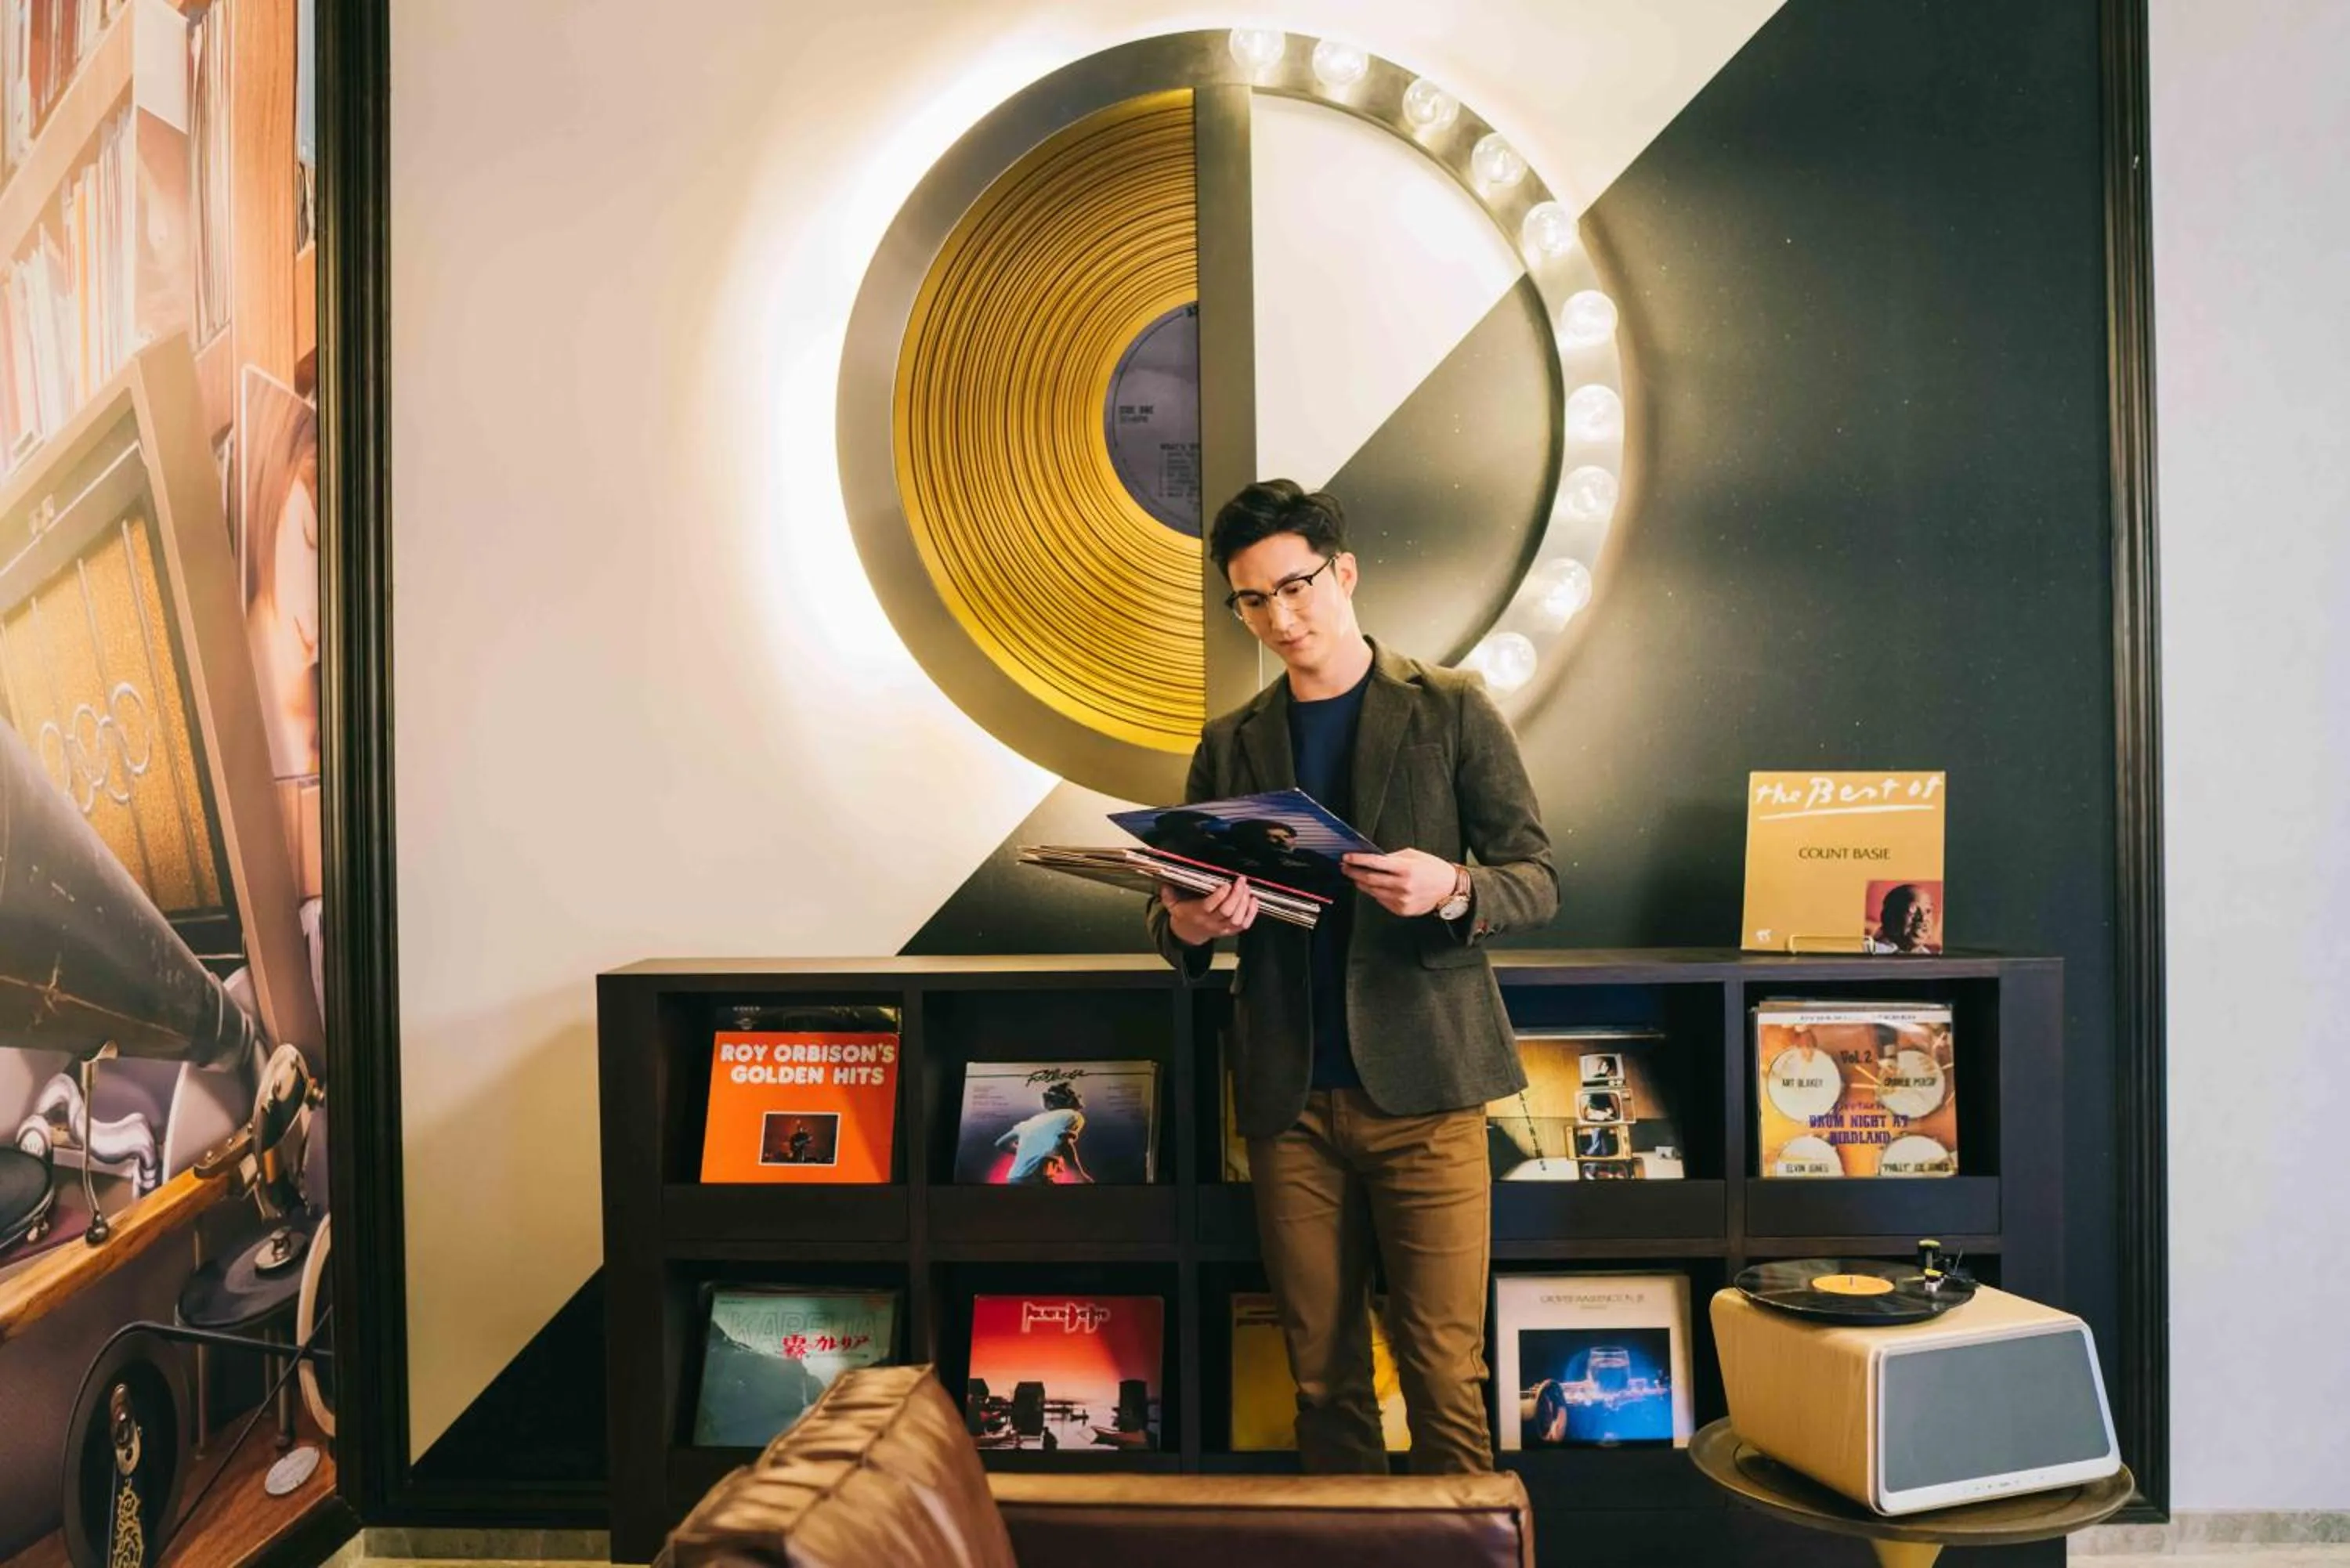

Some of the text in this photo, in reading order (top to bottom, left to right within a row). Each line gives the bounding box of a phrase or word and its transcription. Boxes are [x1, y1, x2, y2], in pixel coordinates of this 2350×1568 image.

[1805, 776, 1899, 809] Best
[1799, 847, 1891, 860] COUNT BASIE
[720, 1042, 895, 1064] ROY ORBISON'S
[1864, 1050, 1873, 1064] 2
[730, 1065, 885, 1086] GOLDEN HITS
[1809, 1115, 1909, 1128] DRUM NIGHT AT
[1829, 1130, 1892, 1145] BIRDLAND
